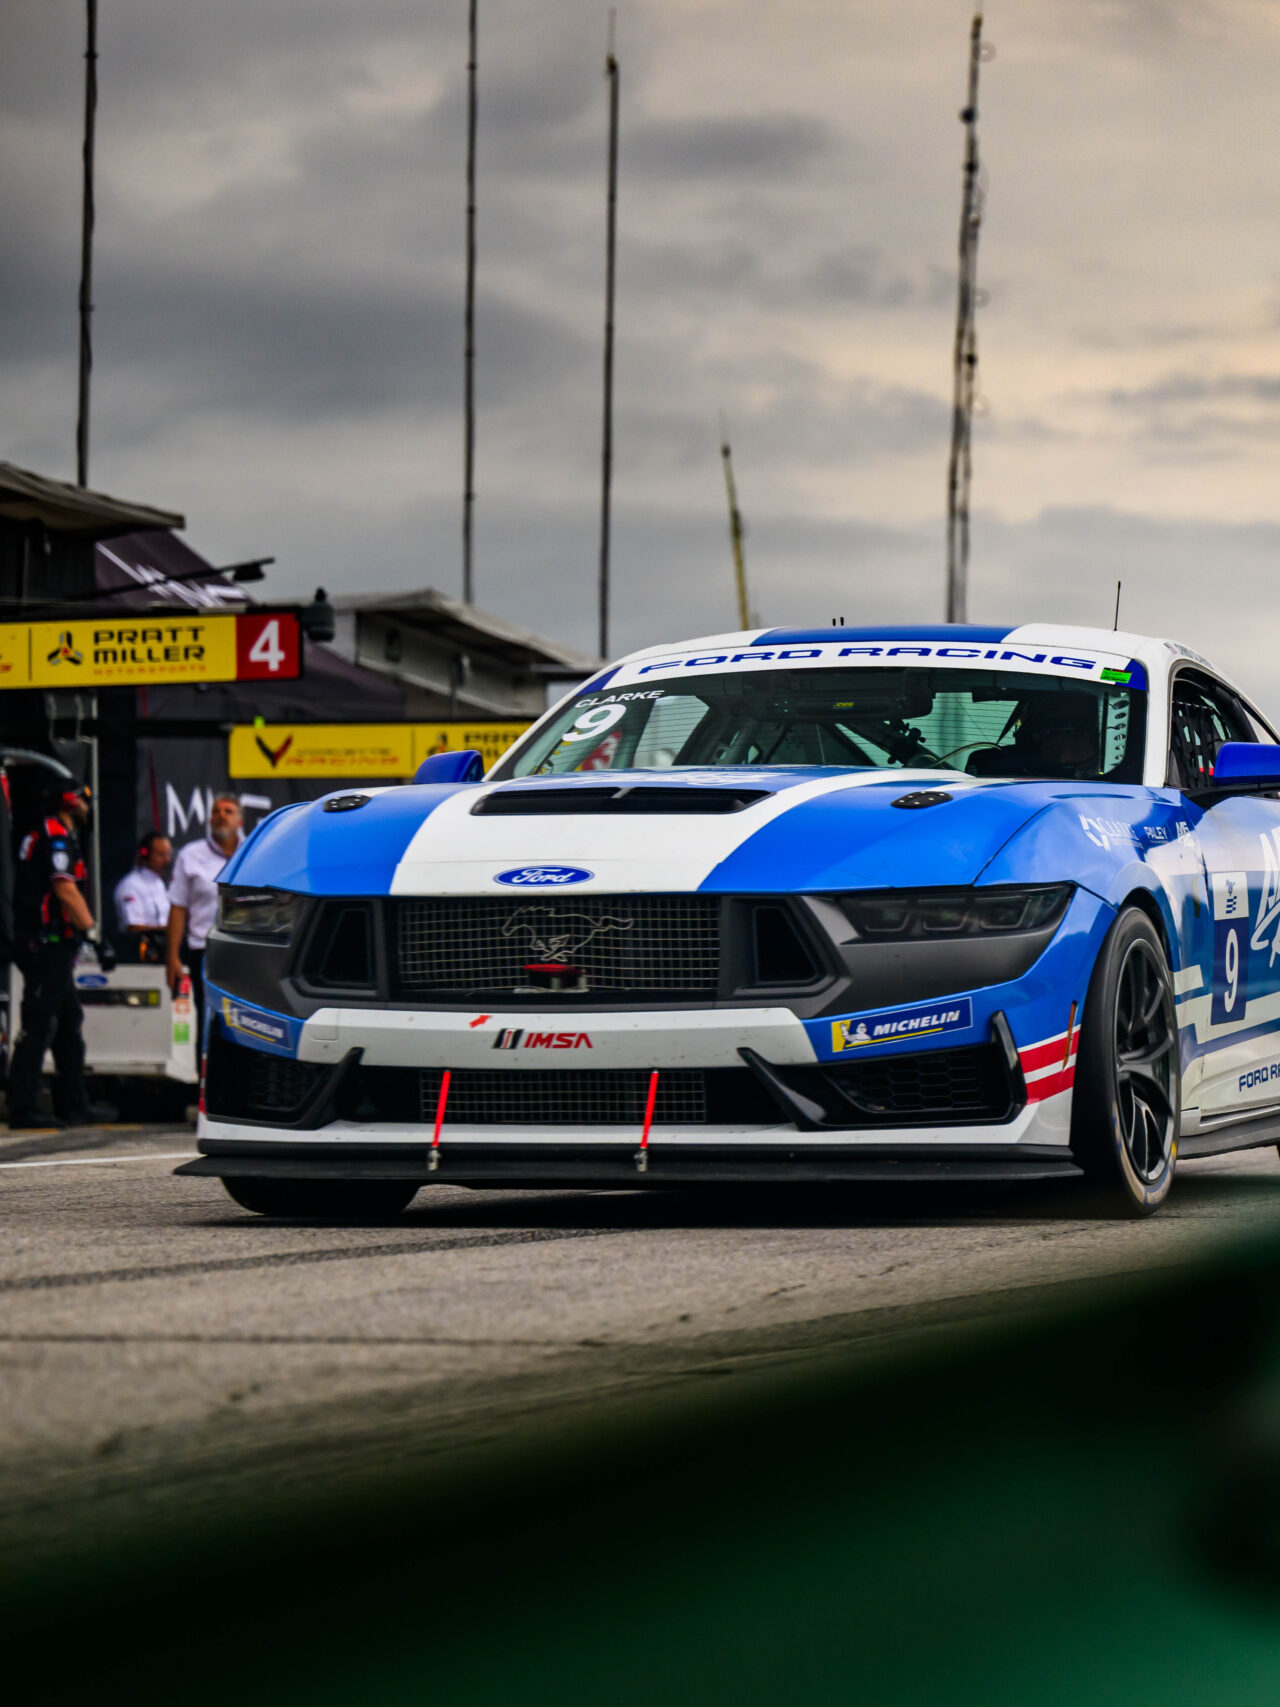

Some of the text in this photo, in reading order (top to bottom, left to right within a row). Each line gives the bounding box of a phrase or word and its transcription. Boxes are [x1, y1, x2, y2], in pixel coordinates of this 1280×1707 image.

[93, 626, 206, 645] PRATT
[249, 619, 285, 672] 4
[93, 646, 206, 664] MILLER
[638, 647, 1097, 674] FORD RACING
[574, 689, 666, 708] CLARKE
[562, 703, 627, 742] 9
[511, 867, 576, 884] Ford
[1224, 928, 1239, 1013] 9
[873, 1010, 960, 1036] MICHELIN
[523, 1032, 594, 1049] IMSA
[1239, 1066, 1269, 1092] FORD
